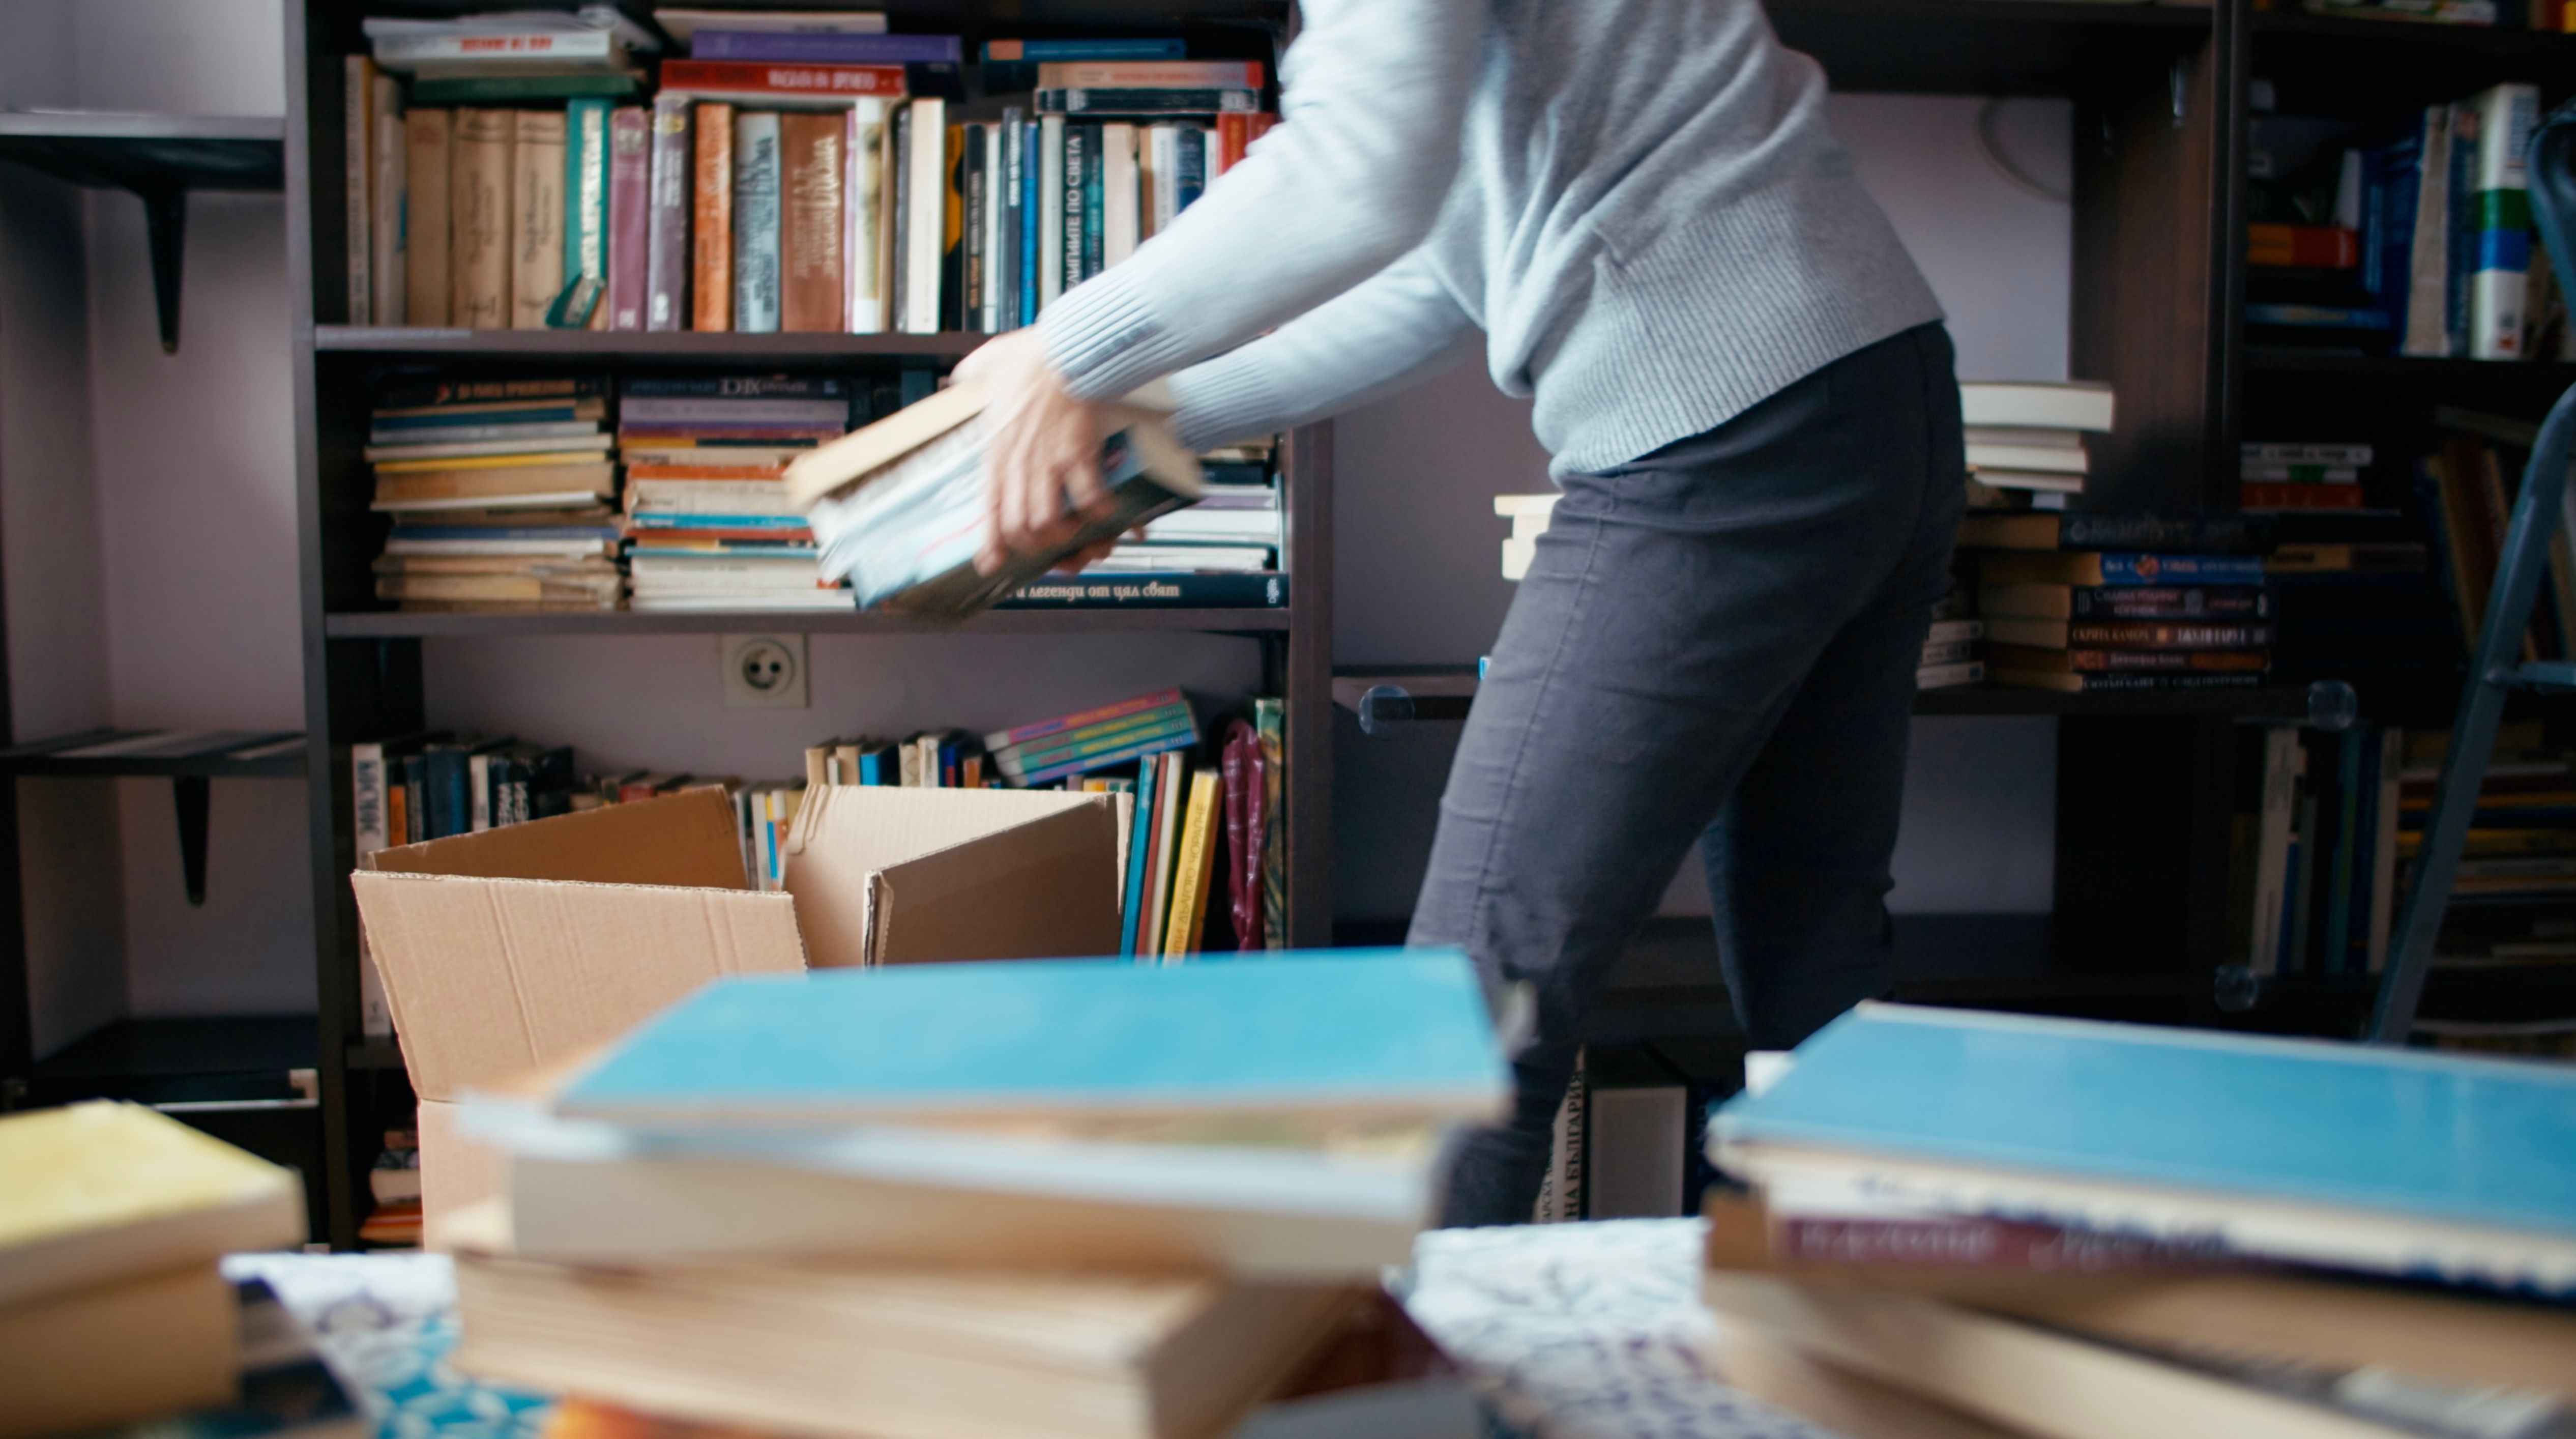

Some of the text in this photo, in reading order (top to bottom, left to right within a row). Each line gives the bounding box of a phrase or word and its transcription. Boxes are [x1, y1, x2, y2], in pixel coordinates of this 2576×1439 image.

[1066, 137, 1081, 186] СВЕТА
[1066, 189, 1081, 213] ПО
[1029, 586, 1084, 602] легенди
[1088, 587, 1109, 597] от
[1113, 587, 1139, 601] цял
[1143, 581, 1179, 597] свят
[1268, 579, 1279, 604] Digest
[1178, 868, 1196, 923] ДЪЛГОТО
[1189, 802, 1206, 864] ЧОРАПЧЕ
[1565, 1072, 1583, 1219] НА БЪЛГАРИЯ
